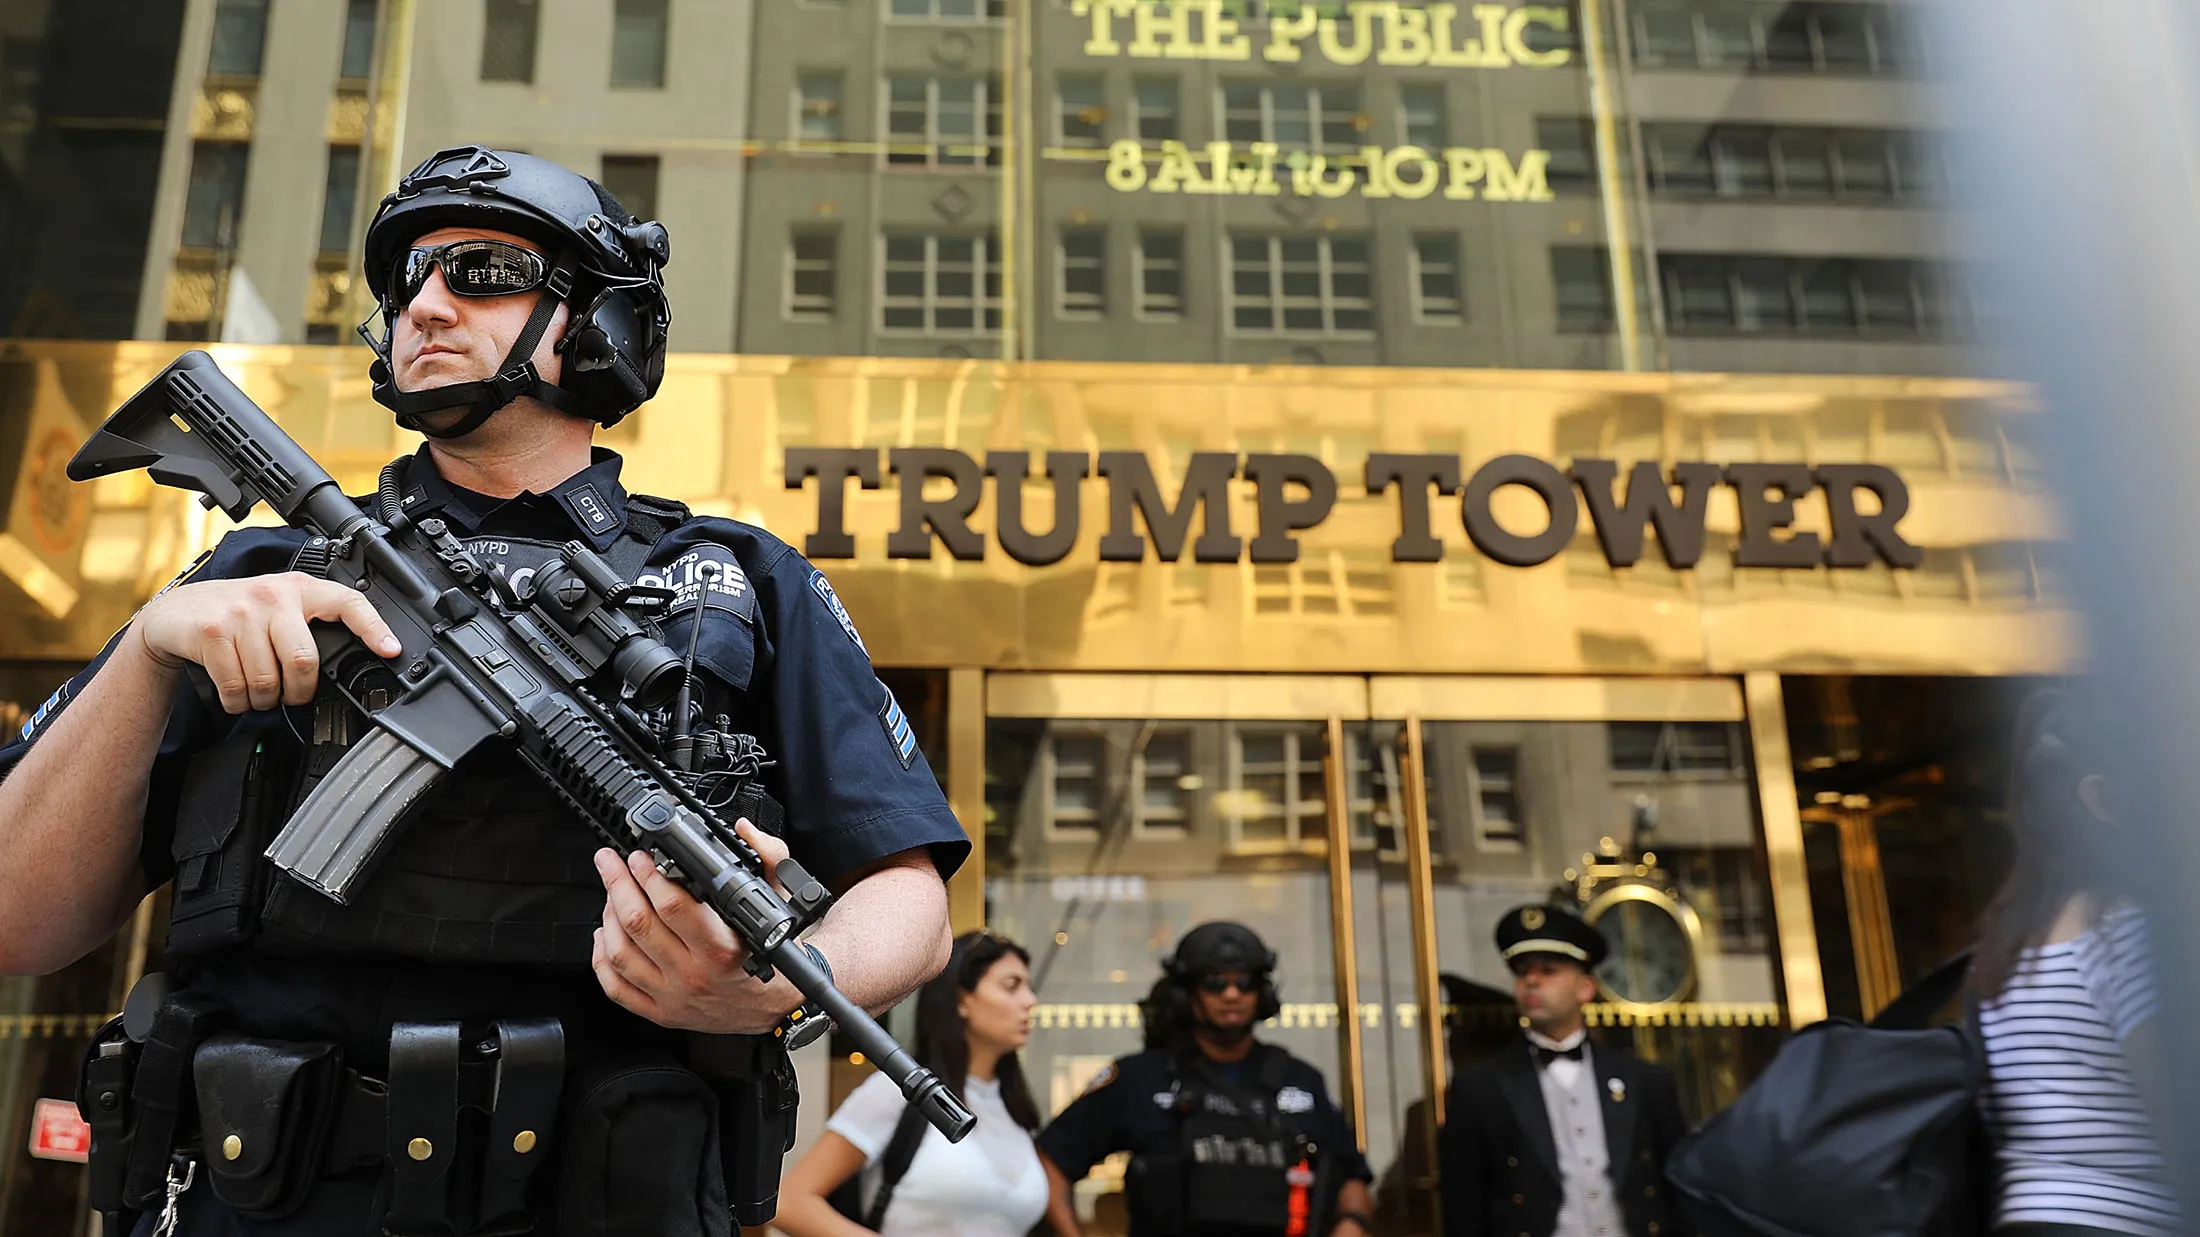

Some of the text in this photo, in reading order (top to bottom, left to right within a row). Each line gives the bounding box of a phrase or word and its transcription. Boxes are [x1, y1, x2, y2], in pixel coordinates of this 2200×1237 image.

[1071, 0, 1571, 67] THE PUBLIC
[1443, 147, 1556, 201] PM
[580, 496, 605, 523] CTB
[784, 447, 1924, 570] TRUMP TOWER
[467, 541, 509, 555] NYPD
[662, 552, 699, 576] NYPD
[634, 559, 747, 591] OLICE
